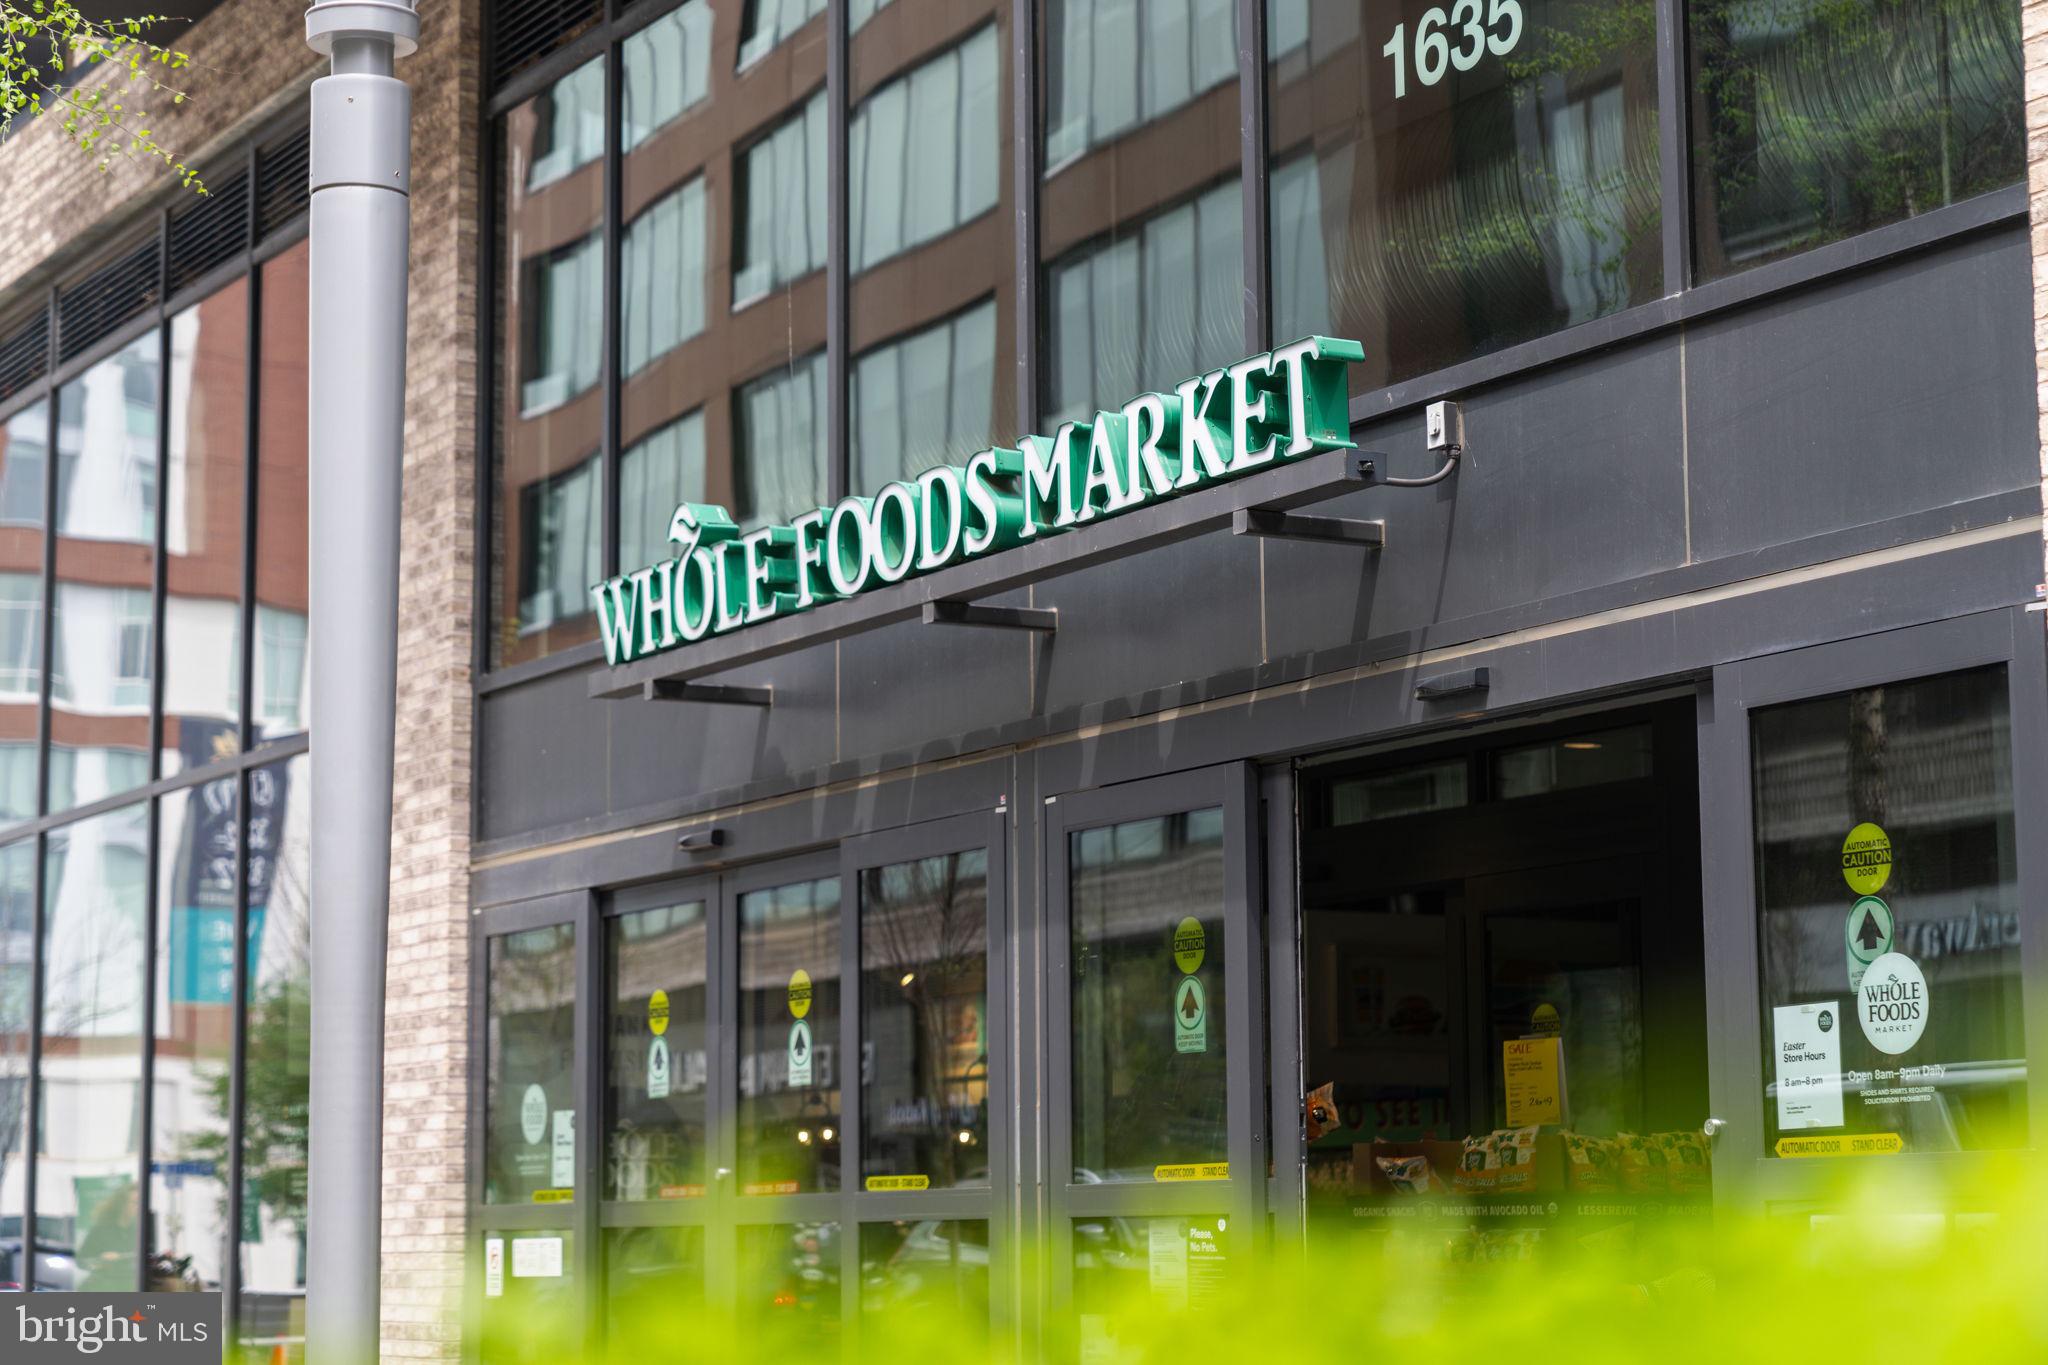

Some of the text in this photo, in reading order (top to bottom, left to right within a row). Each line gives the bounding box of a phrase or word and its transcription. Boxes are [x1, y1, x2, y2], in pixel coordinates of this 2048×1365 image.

[1384, 0, 1523, 99] 1635
[591, 336, 1325, 666] WHOLE FOODS MARKET
[1846, 838, 1887, 850] AUTOMATIC
[1842, 849, 1892, 867] CAUTION
[1857, 867, 1877, 877] DOOR
[1175, 939, 1206, 951] CAUTION
[1864, 974, 1920, 1002] WHOLE
[1868, 1001, 1920, 1022] FOODS
[1874, 1024, 1912, 1033] MARKET
[1508, 1044, 1534, 1054] SALE
[1783, 1042, 1806, 1051] Easter
[1783, 1052, 1826, 1063] Store Hours
[1848, 1070, 1873, 1083] Open
[1922, 1063, 1946, 1078] Daily
[1890, 1087, 1908, 1095] SHIRTS
[1864, 1094, 1931, 1104] SOLICITATION PROHIBITED
[1781, 1138, 1898, 1153] AUTOMATIC DOOR STAND CLEAR
[1158, 1168, 1182, 1178] AUTOMATIC
[1183, 1167, 1195, 1176] DOOR
[1203, 1167, 1217, 1176] STAND
[1353, 1207, 1385, 1217] ORGANIC
[1441, 1206, 1465, 1216] MADE
[1466, 1206, 1488, 1216] WITH
[1489, 1206, 1528, 1216] AVOCADO
[1530, 1205, 1544, 1215] OIL
[1577, 1205, 1638, 1216] LESSEREVIL
[1190, 1228, 1213, 1240] Please,
[1190, 1242, 1218, 1252] No Pets.
